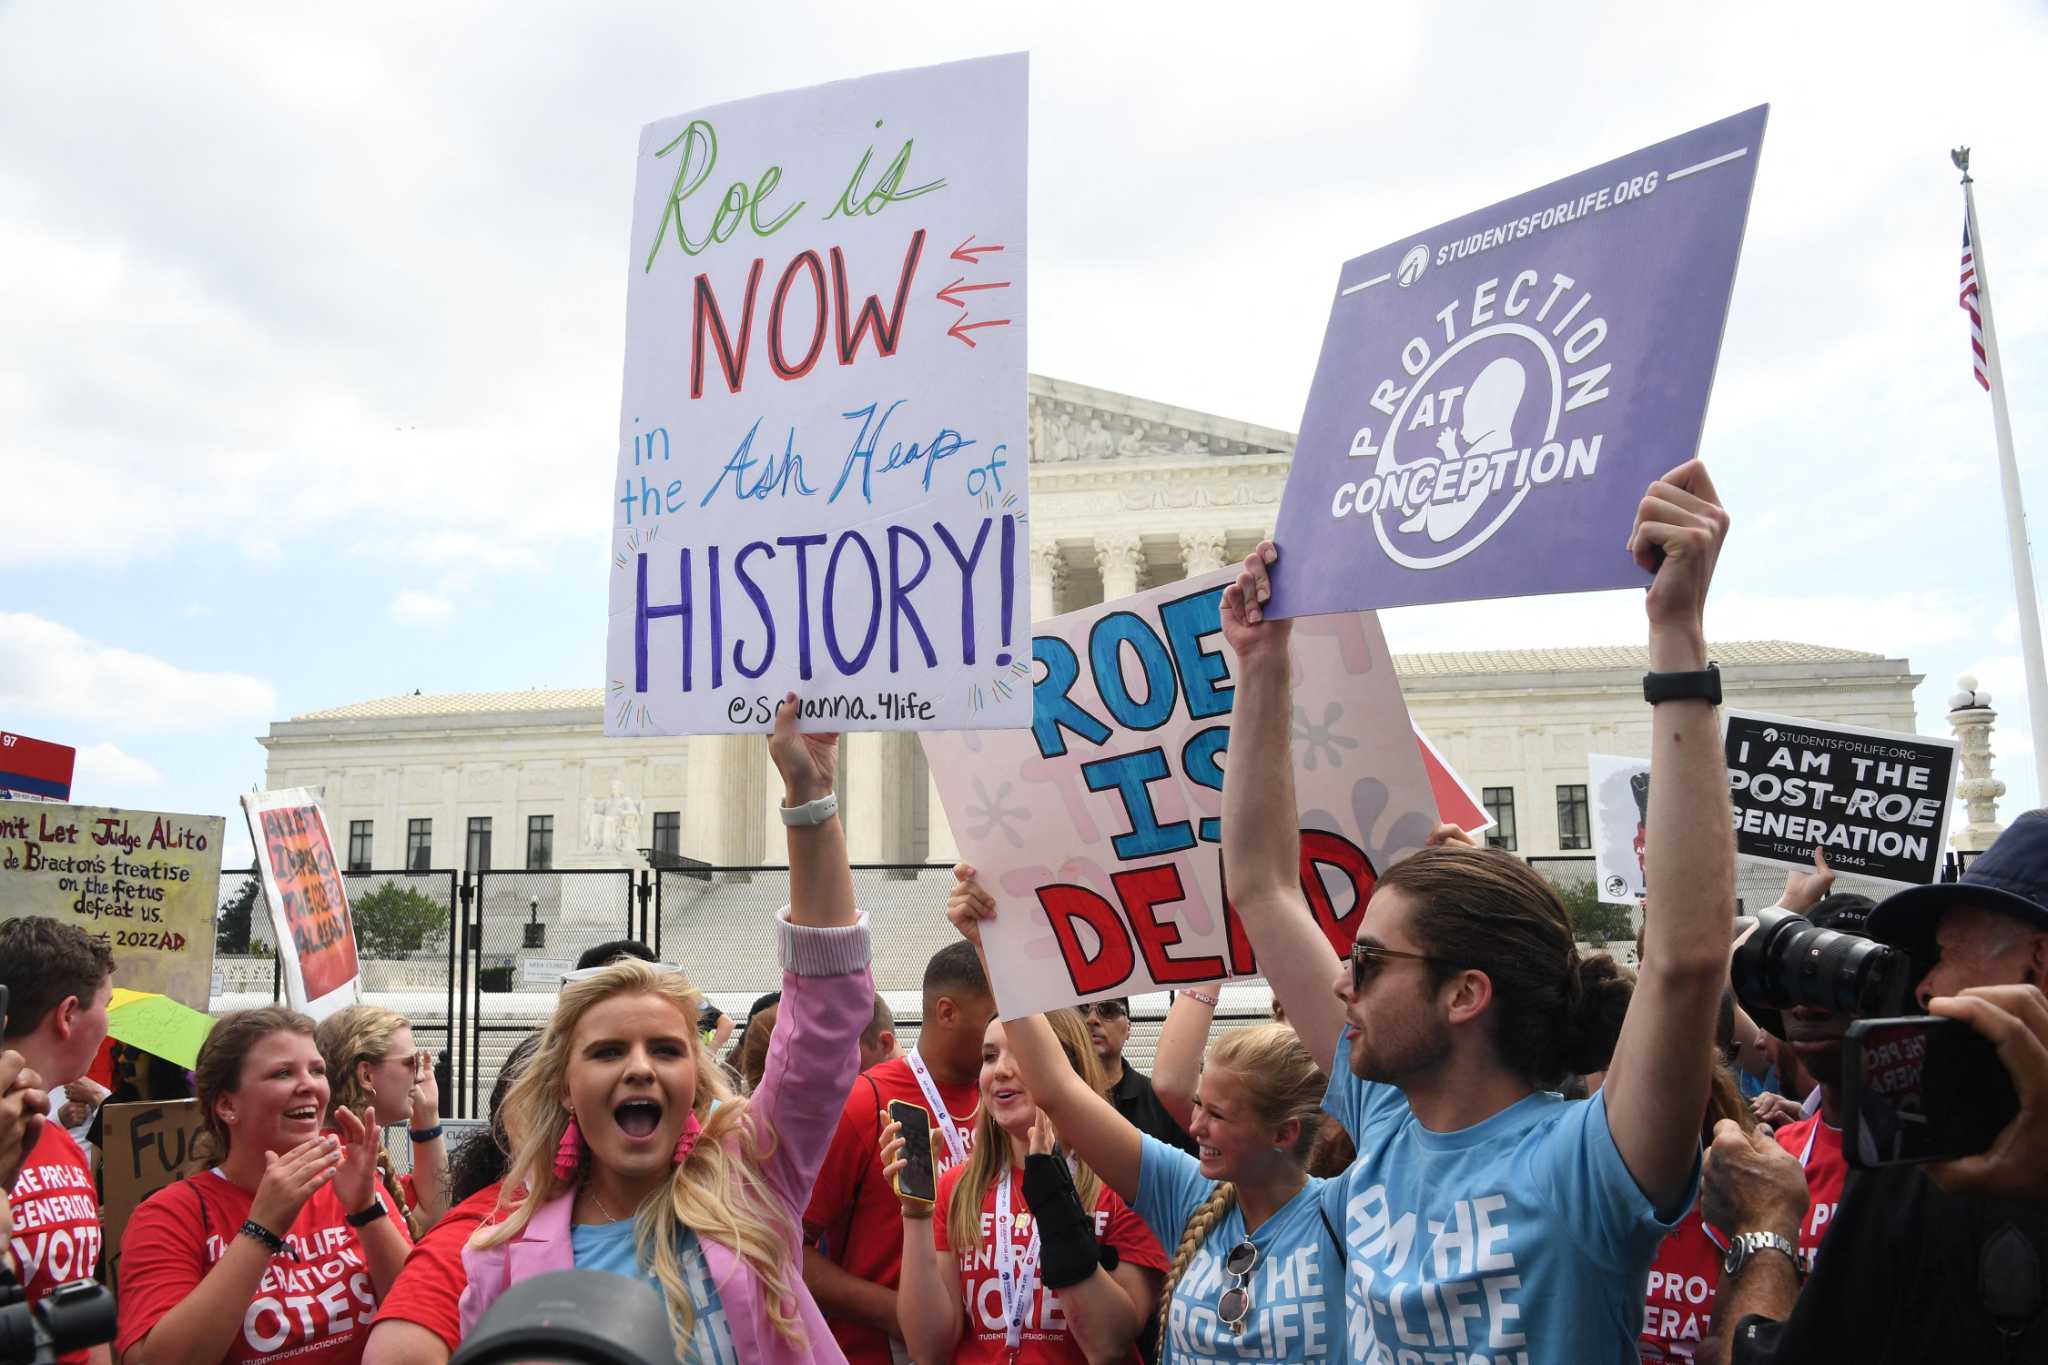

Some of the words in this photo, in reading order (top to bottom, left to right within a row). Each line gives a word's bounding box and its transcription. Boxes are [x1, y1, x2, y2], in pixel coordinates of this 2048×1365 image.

[646, 120, 806, 274] Roe
[822, 119, 947, 220] is
[1436, 170, 1660, 266] STUDENTSFORLIFE.ORG
[691, 228, 926, 399] NOW
[1348, 269, 1612, 458] PROTECTION
[1408, 385, 1464, 432] AT
[620, 476, 687, 525] the
[701, 416, 818, 508] Ash
[827, 399, 976, 504] Heap
[966, 444, 1008, 496] of
[634, 417, 670, 466] in
[1331, 434, 1604, 519] CONCEPTION
[635, 514, 1015, 693] HISTORY!
[1031, 581, 1237, 760] ROE
[1738, 741, 1750, 763] I
[1767, 747, 1831, 776] AM
[1851, 757, 1931, 790] THE
[1780, 732, 1917, 761] STUDENTSFORLIFE.ORG
[1727, 768, 1942, 828] POST-ROE
[39, 813, 78, 844] Let
[1733, 806, 1928, 862] GENERATION
[1773, 843, 1795, 854] TEXT
[1797, 847, 1817, 859] LIFE
[1822, 852, 1833, 861] O
[1835, 854, 1866, 866] 53445
[59, 877, 78, 892] on
[85, 876, 109, 894] the
[112, 855, 190, 881] treatise
[74, 891, 134, 919] defeat
[141, 905, 164, 923] us.
[1035, 828, 1378, 997] DED
[11, 1194, 97, 1231] GENERATIO
[244, 1273, 378, 1352] OTES
